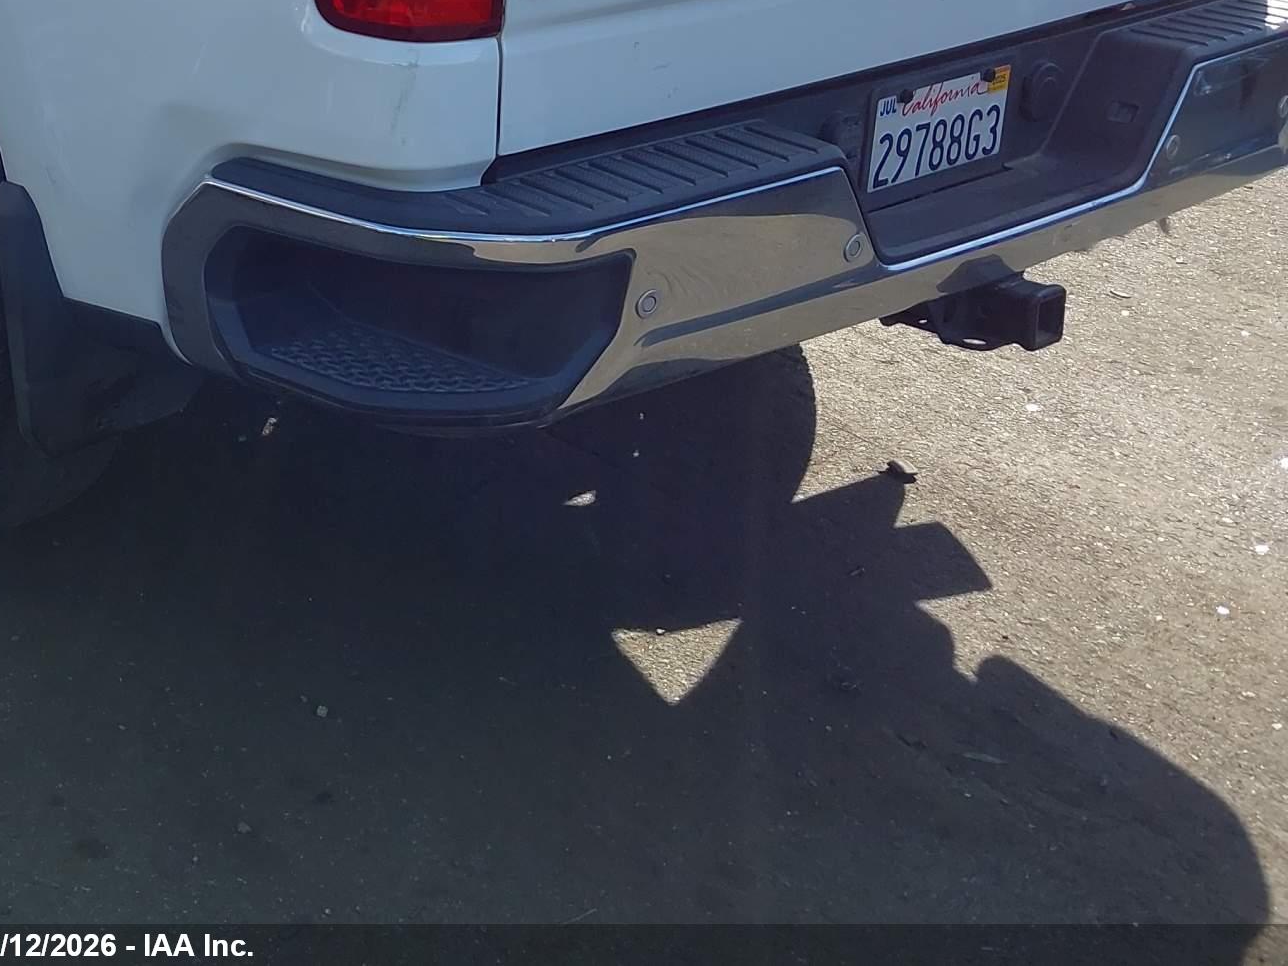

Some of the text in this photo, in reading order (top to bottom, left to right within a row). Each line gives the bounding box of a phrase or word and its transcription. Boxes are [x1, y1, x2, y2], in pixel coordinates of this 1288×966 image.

[880, 98, 897, 117] JUL
[902, 81, 989, 117] California
[873, 104, 1001, 189] 29788G3
